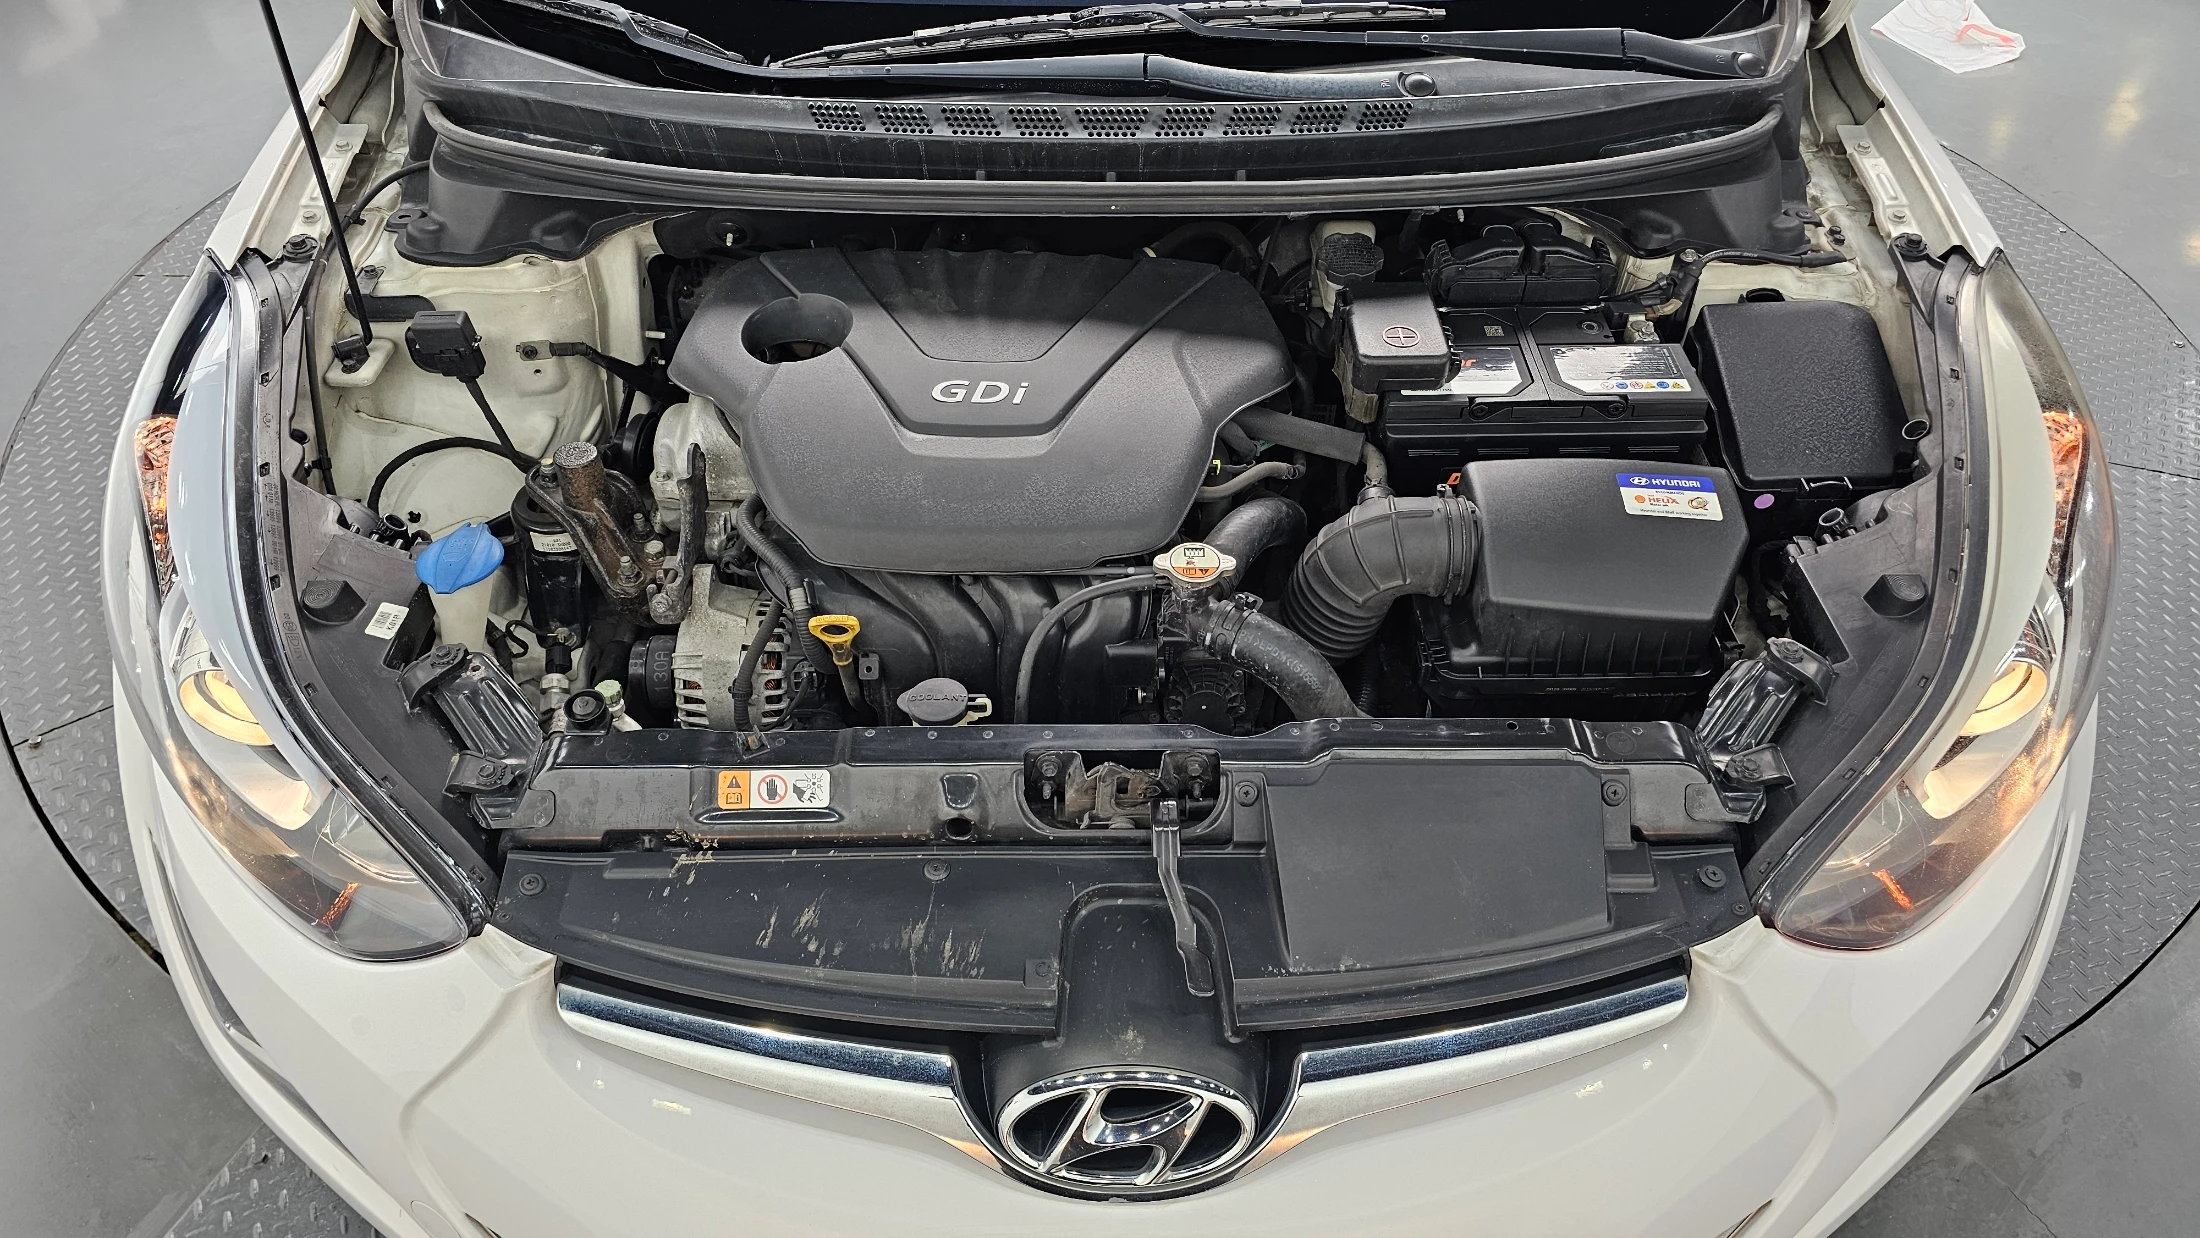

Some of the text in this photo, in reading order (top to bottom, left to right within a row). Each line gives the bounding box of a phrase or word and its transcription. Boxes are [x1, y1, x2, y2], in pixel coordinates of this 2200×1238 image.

[931, 380, 1029, 405] GDi
[1652, 478, 1701, 488] HYUNDAI
[1648, 496, 1680, 505] HELIX
[653, 651, 670, 692] 130A
[909, 693, 967, 702] COOLANT
